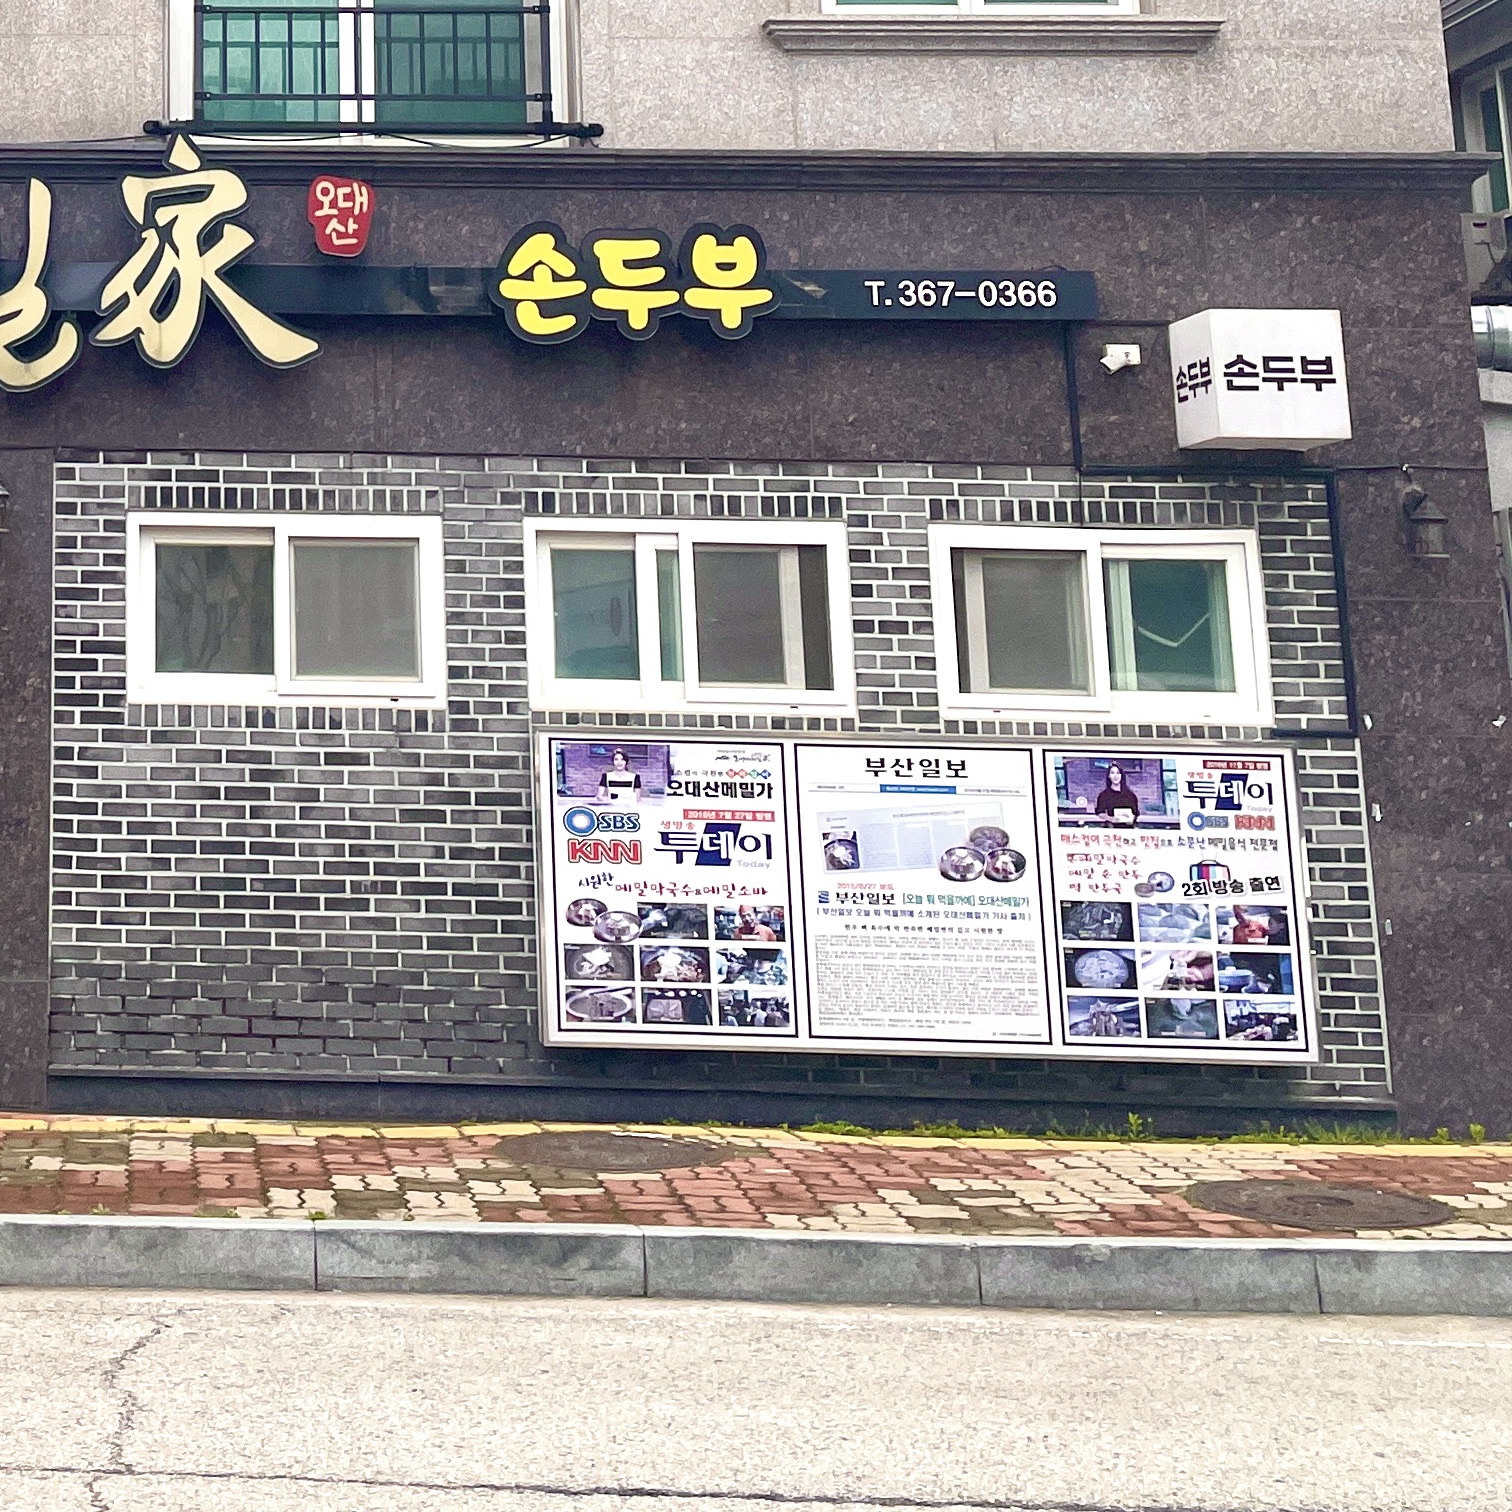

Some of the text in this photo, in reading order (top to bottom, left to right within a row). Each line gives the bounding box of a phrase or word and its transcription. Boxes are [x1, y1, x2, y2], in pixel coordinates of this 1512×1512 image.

[499, 232, 774, 336] 손두부
[1175, 356, 1213, 403] 손두부
[1223, 354, 1337, 392] 손두부
[865, 757, 968, 778] 부산일보
[667, 780, 774, 799] 오대산메밀가
[1183, 779, 1273, 809] 투데이
[599, 813, 640, 832] SBS
[568, 839, 642, 864] KNN
[654, 830, 773, 865] 투데이
[737, 860, 771, 869] Today
[578, 872, 614, 889] 시원한
[1181, 876, 1282, 896] 2회 방송 출연
[835, 892, 896, 905] 부산일보
